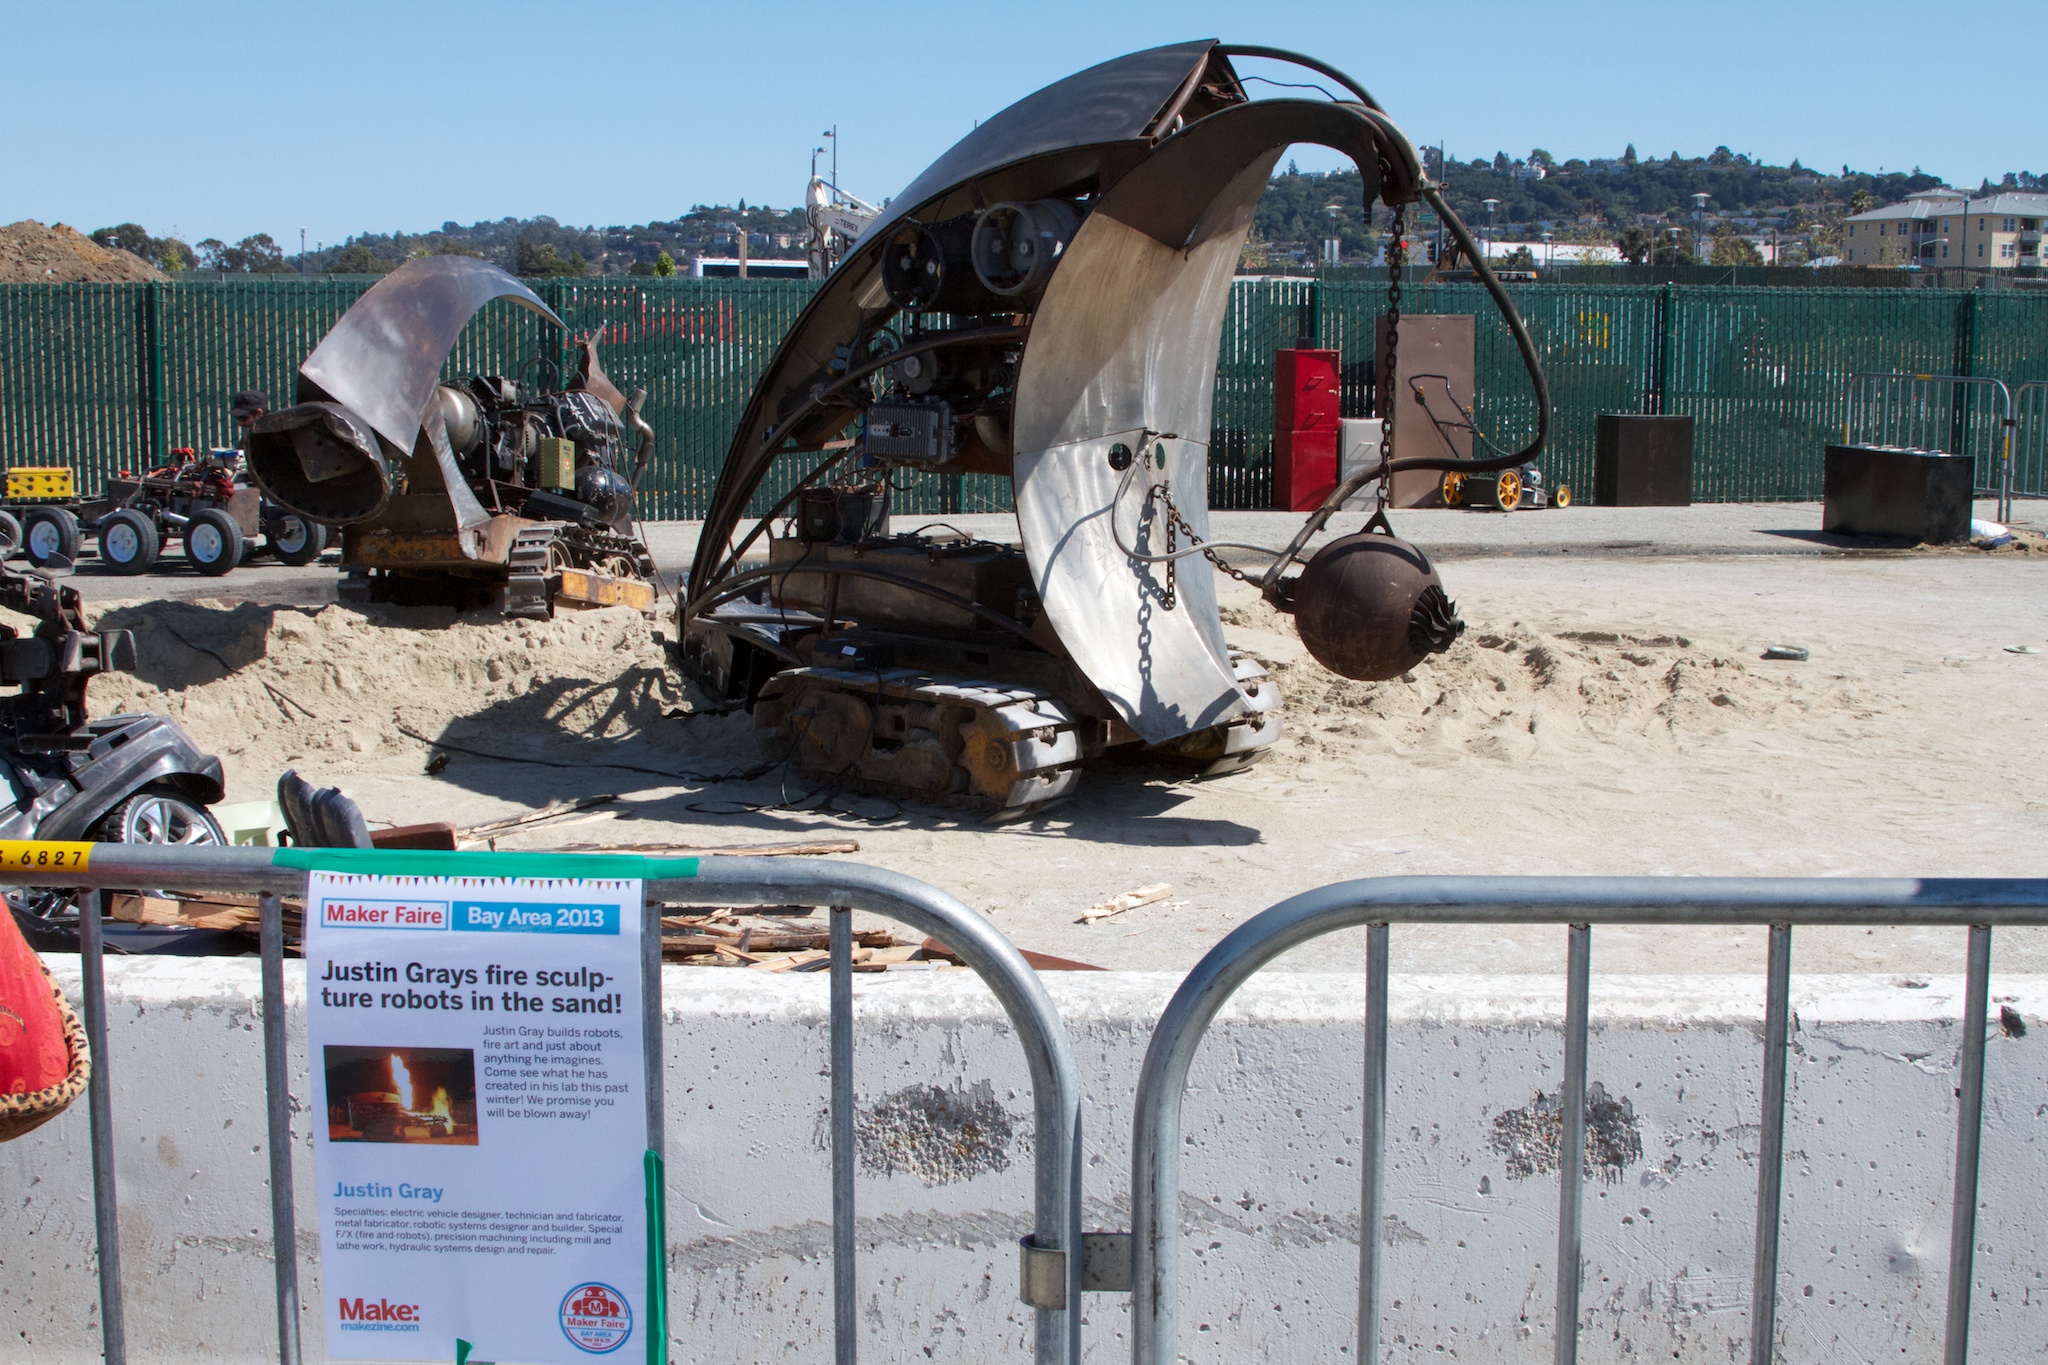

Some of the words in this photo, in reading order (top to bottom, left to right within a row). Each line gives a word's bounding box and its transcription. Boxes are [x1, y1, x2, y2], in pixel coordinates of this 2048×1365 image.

[840, 219, 858, 232] TEREX
[327, 905, 388, 923] Maker
[395, 906, 442, 924] Faire
[468, 907, 503, 928] Bay
[508, 908, 552, 926] Area
[556, 909, 604, 927] 2013
[321, 960, 398, 982] Justin
[406, 962, 478, 988] Grays
[485, 965, 528, 985] fire
[536, 967, 614, 992] sculp-
[322, 988, 372, 1008] ture
[381, 989, 463, 1010] robots
[472, 990, 494, 1011] in
[501, 992, 544, 1012] the
[551, 994, 621, 1014] sand!
[483, 1026, 515, 1036] Justin
[519, 1026, 544, 1038] Gray
[547, 1027, 581, 1037] builds
[584, 1028, 623, 1038] robots,
[483, 1040, 501, 1049] fire
[504, 1041, 519, 1050] art
[523, 1041, 543, 1050] and
[546, 1042, 566, 1052] just
[569, 1042, 601, 1051] about
[484, 1054, 532, 1065] anything
[535, 1055, 548, 1064] he
[551, 1055, 603, 1067] imagines.
[485, 1067, 517, 1077] Come
[520, 1069, 539, 1077] see
[542, 1069, 568, 1078] what
[572, 1069, 585, 1078] he
[588, 1069, 608, 1078] has
[485, 1082, 527, 1091] created
[530, 1082, 540, 1090] in
[543, 1082, 558, 1092] his
[562, 1083, 578, 1092] lab
[581, 1083, 601, 1092] this
[605, 1083, 629, 1094] past
[486, 1095, 524, 1104] winter!
[527, 1096, 543, 1105] We
[547, 1097, 591, 1106] promise
[594, 1098, 614, 1107] you
[487, 1109, 504, 1117] will
[508, 1109, 521, 1118] be
[524, 1109, 556, 1119] blown
[560, 1110, 591, 1121] away!
[334, 1182, 392, 1198] Justin
[399, 1183, 443, 1202] Gray
[335, 1207, 388, 1216] Specialties:
[390, 1208, 424, 1217] electric
[427, 1209, 458, 1218] vehicle
[461, 1210, 503, 1220] designer,
[505, 1212, 553, 1220] technician
[576, 1213, 624, 1223] fabricator,
[335, 1219, 362, 1227] metal
[364, 1220, 411, 1228] fabricator,
[414, 1221, 446, 1229] robotic
[449, 1222, 487, 1231] systems
[490, 1223, 529, 1232] designer
[588, 1225, 622, 1234] Special
[336, 1230, 353, 1238] F/X
[355, 1230, 374, 1240] (fire
[377, 1231, 394, 1239] and
[396, 1232, 432, 1241] robots),
[435, 1232, 476, 1242] precision
[479, 1234, 527, 1244] machining
[530, 1235, 572, 1245] including
[575, 1236, 591, 1244] mill
[594, 1236, 611, 1244] and
[337, 1242, 360, 1250] lathe
[390, 1243, 431, 1252] hydraulic
[434, 1244, 472, 1253] systems
[475, 1245, 505, 1254] design
[508, 1246, 524, 1254] and
[527, 1247, 556, 1255] repair.
[339, 1298, 419, 1321] Make:
[341, 1322, 419, 1331] makezine.com
[567, 1317, 598, 1327] Maker
[601, 1319, 625, 1328] Faire
